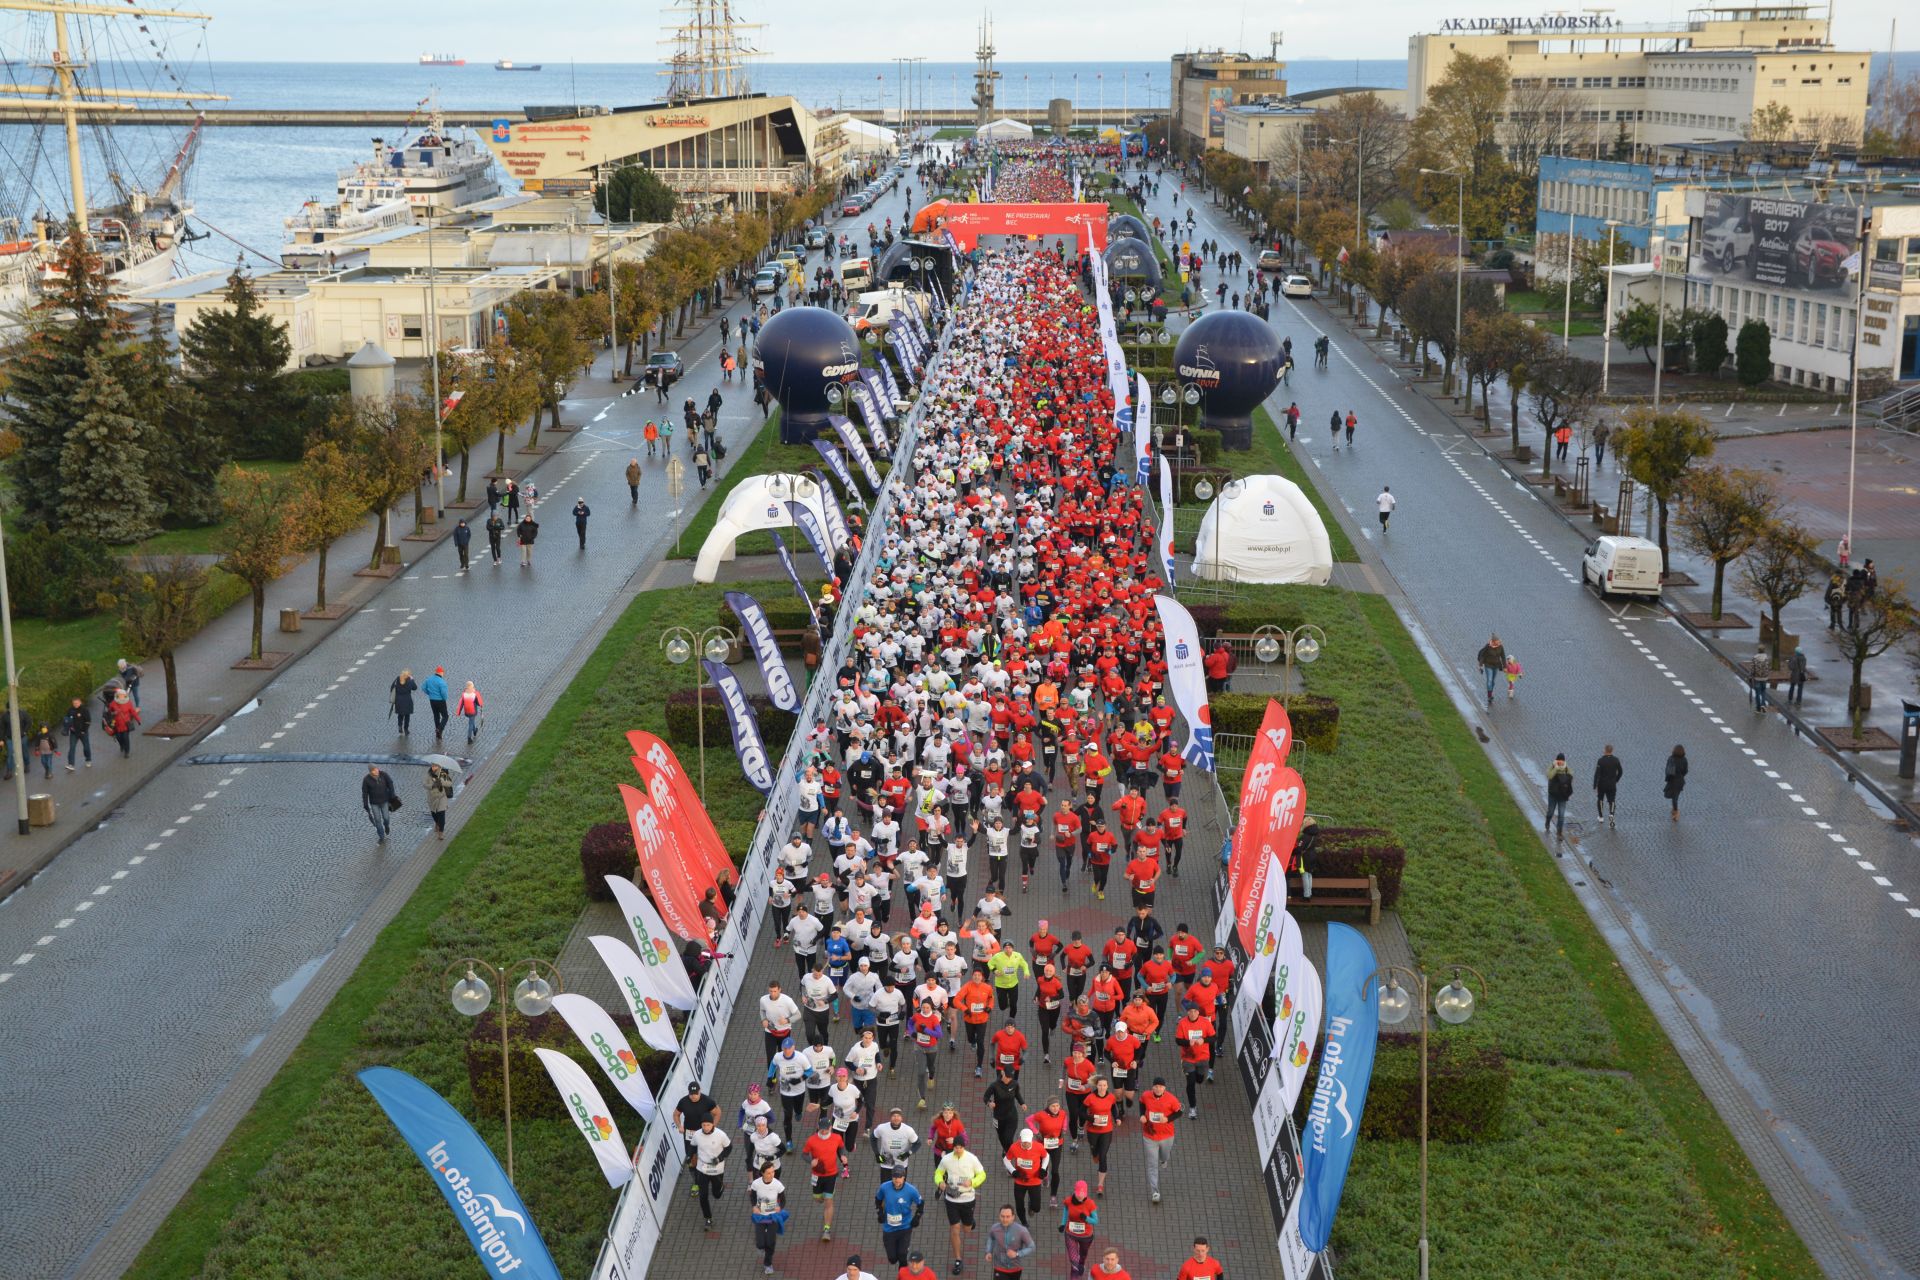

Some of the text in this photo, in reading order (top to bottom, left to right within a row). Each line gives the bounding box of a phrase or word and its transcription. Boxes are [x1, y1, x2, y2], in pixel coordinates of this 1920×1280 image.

[1441, 15, 1613, 30] AKADEMIA MORSKA
[1751, 199, 1807, 218] PREMIERY
[1765, 219, 1789, 232] 2017
[1180, 365, 1220, 379] GDYNIA
[1248, 546, 1291, 554] www.pkobp.pl
[694, 1025, 711, 1082] GDYNIA
[648, 1132, 671, 1202] GDYNIA
